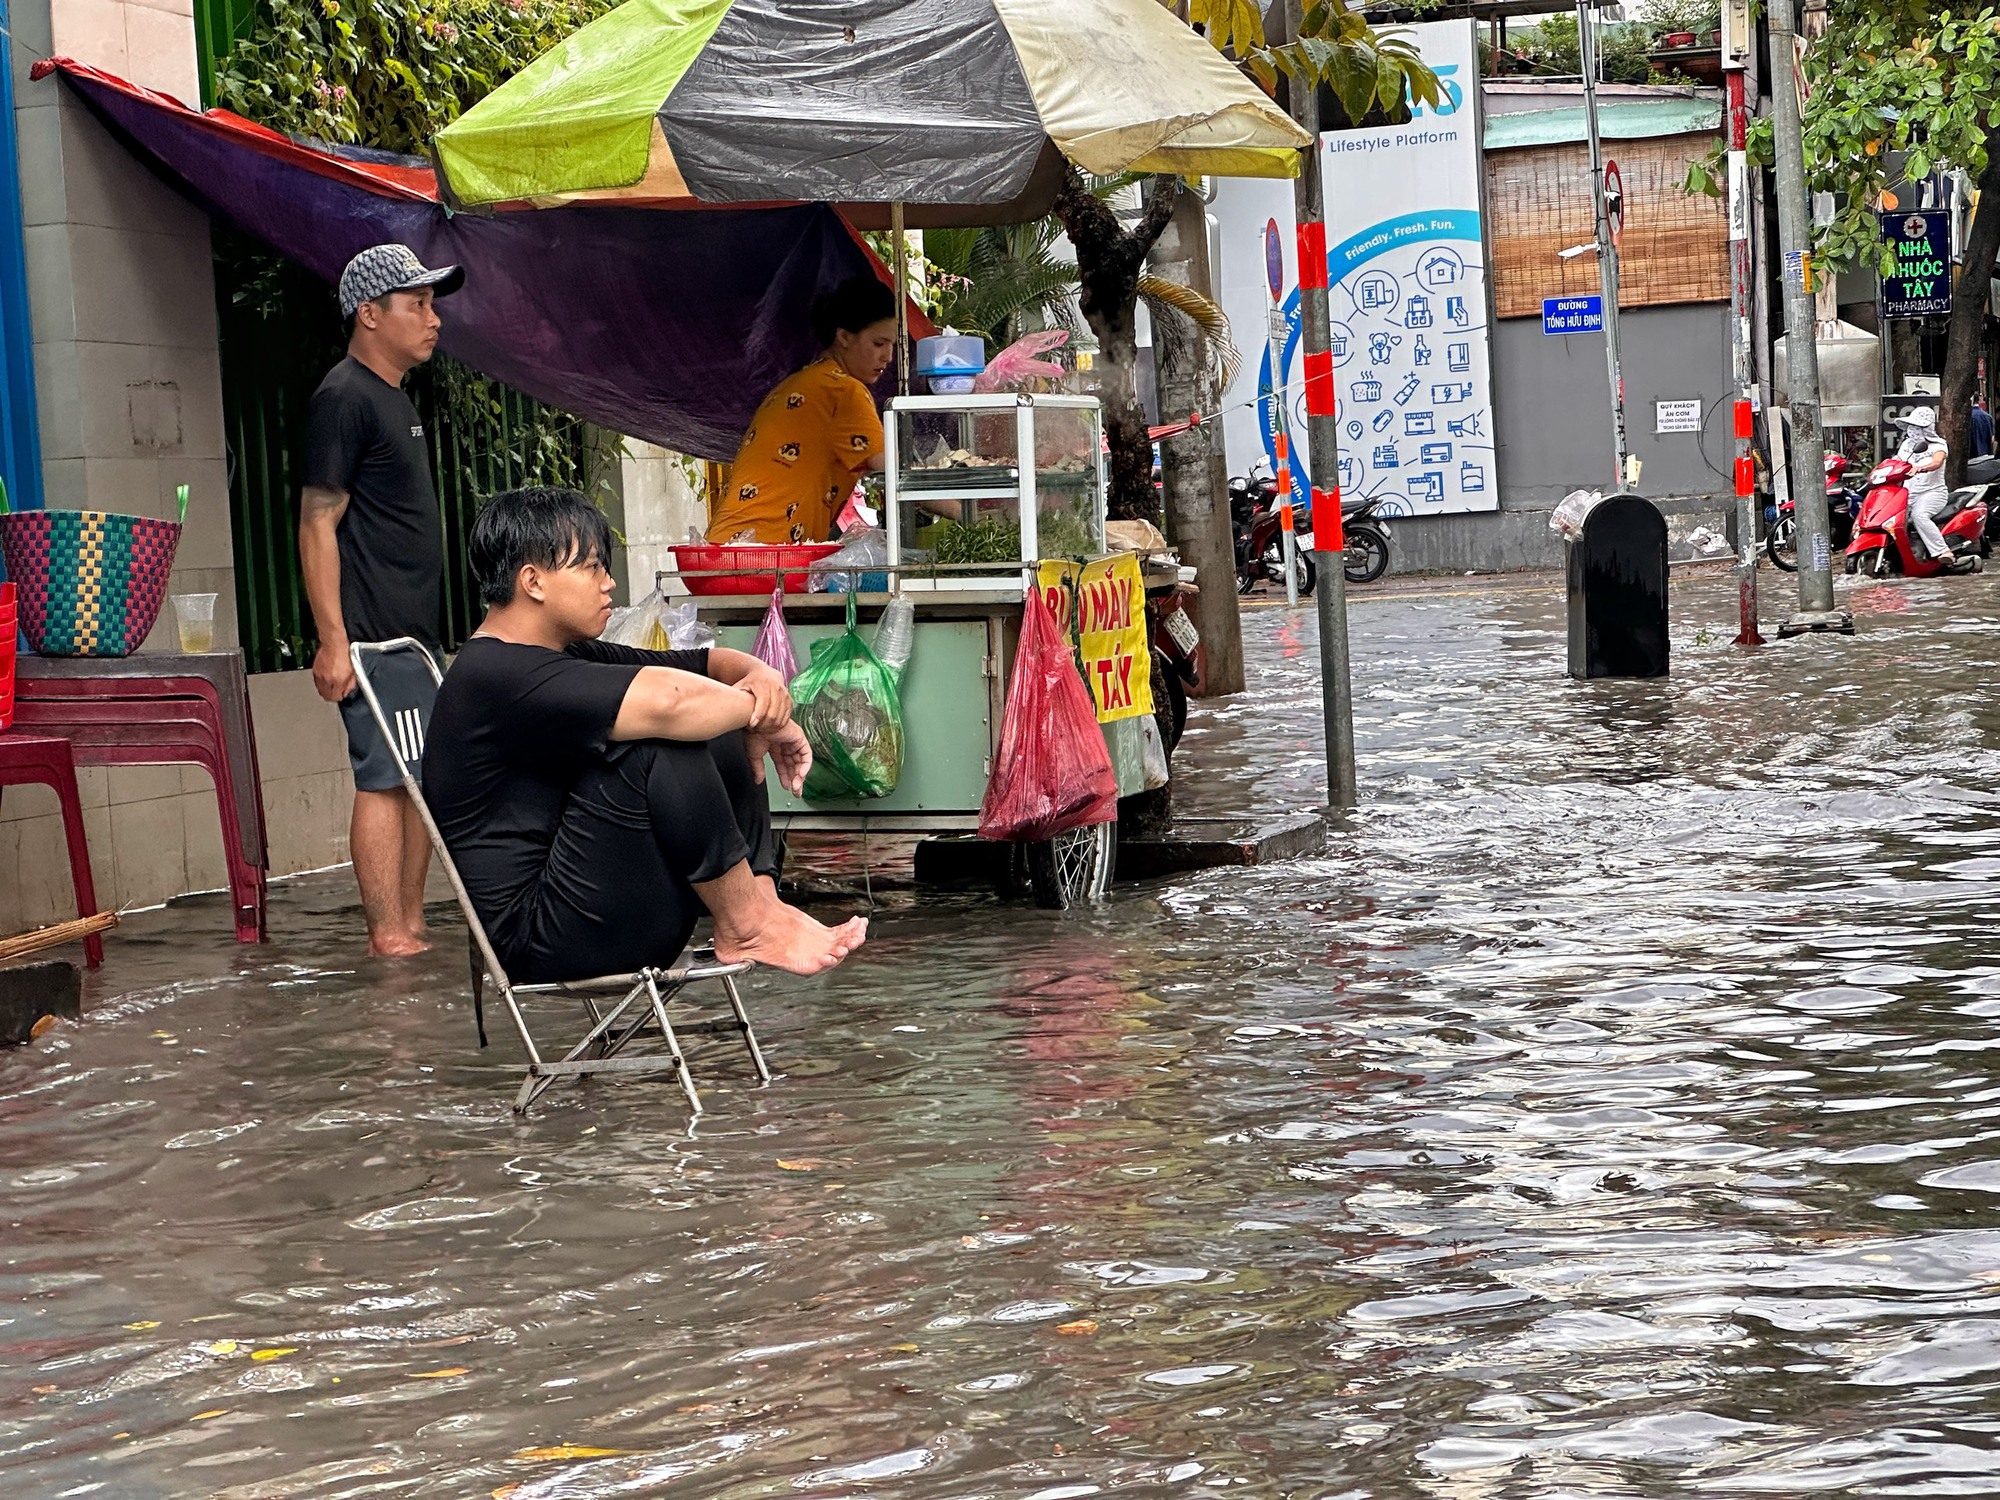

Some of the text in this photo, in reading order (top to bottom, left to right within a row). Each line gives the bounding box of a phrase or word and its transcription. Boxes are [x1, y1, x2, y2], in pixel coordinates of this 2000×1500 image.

[1330, 131, 1458, 153] Lifestyle Platform
[1345, 219, 1455, 261] Friendly. Fresh. Fun.
[1898, 236, 1933, 257] NHÀ
[1891, 258, 1944, 279] HUỐC
[1902, 278, 1935, 299] TÂY
[1557, 299, 1588, 311] ĐƯỜNG
[1887, 298, 1949, 313] PHARMACY
